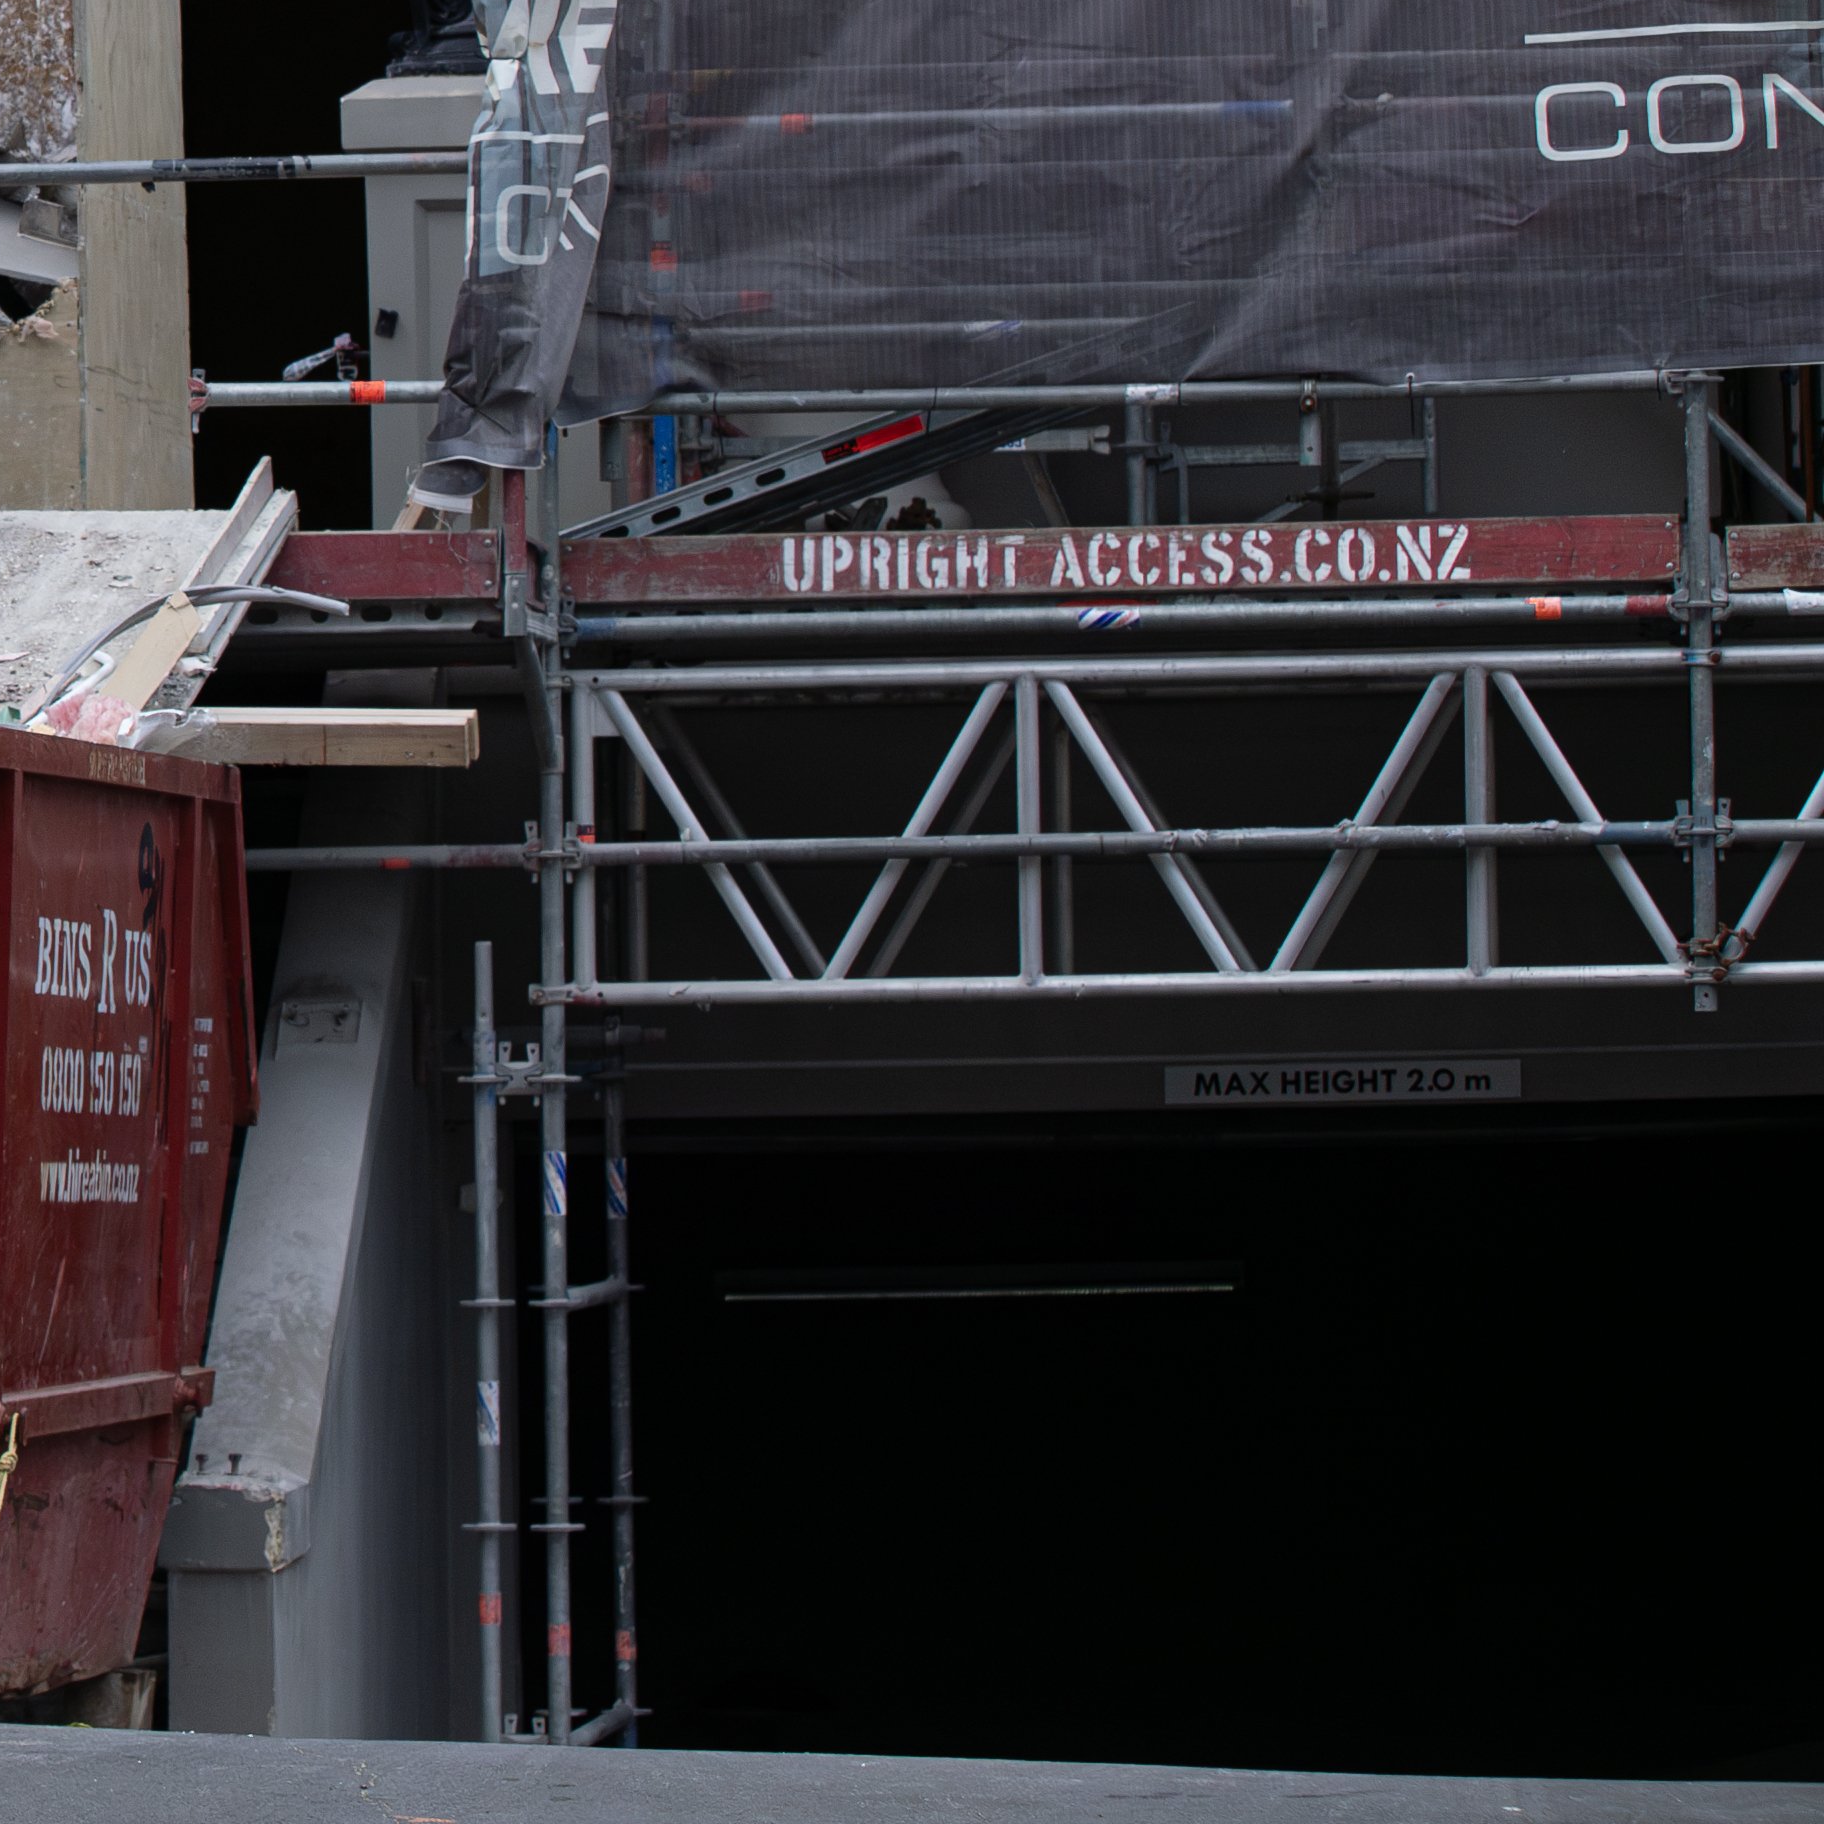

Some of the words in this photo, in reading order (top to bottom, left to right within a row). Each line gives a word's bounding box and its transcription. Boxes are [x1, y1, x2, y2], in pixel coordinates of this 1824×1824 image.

[1534, 74, 1824, 162] CON
[781, 534, 1027, 592] UPRIGHT
[1051, 523, 1471, 588] ACCESS.CO.NZ
[34, 915, 92, 1001] BINS
[97, 907, 118, 1015] R
[123, 928, 152, 1008] US
[41, 1046, 85, 1114] 0800
[89, 1050, 116, 1117] 150
[118, 1052, 143, 1117] 150
[1192, 1070, 1272, 1097] MAX
[1279, 1068, 1398, 1095] HEIGHT
[1463, 1074, 1492, 1092] m
